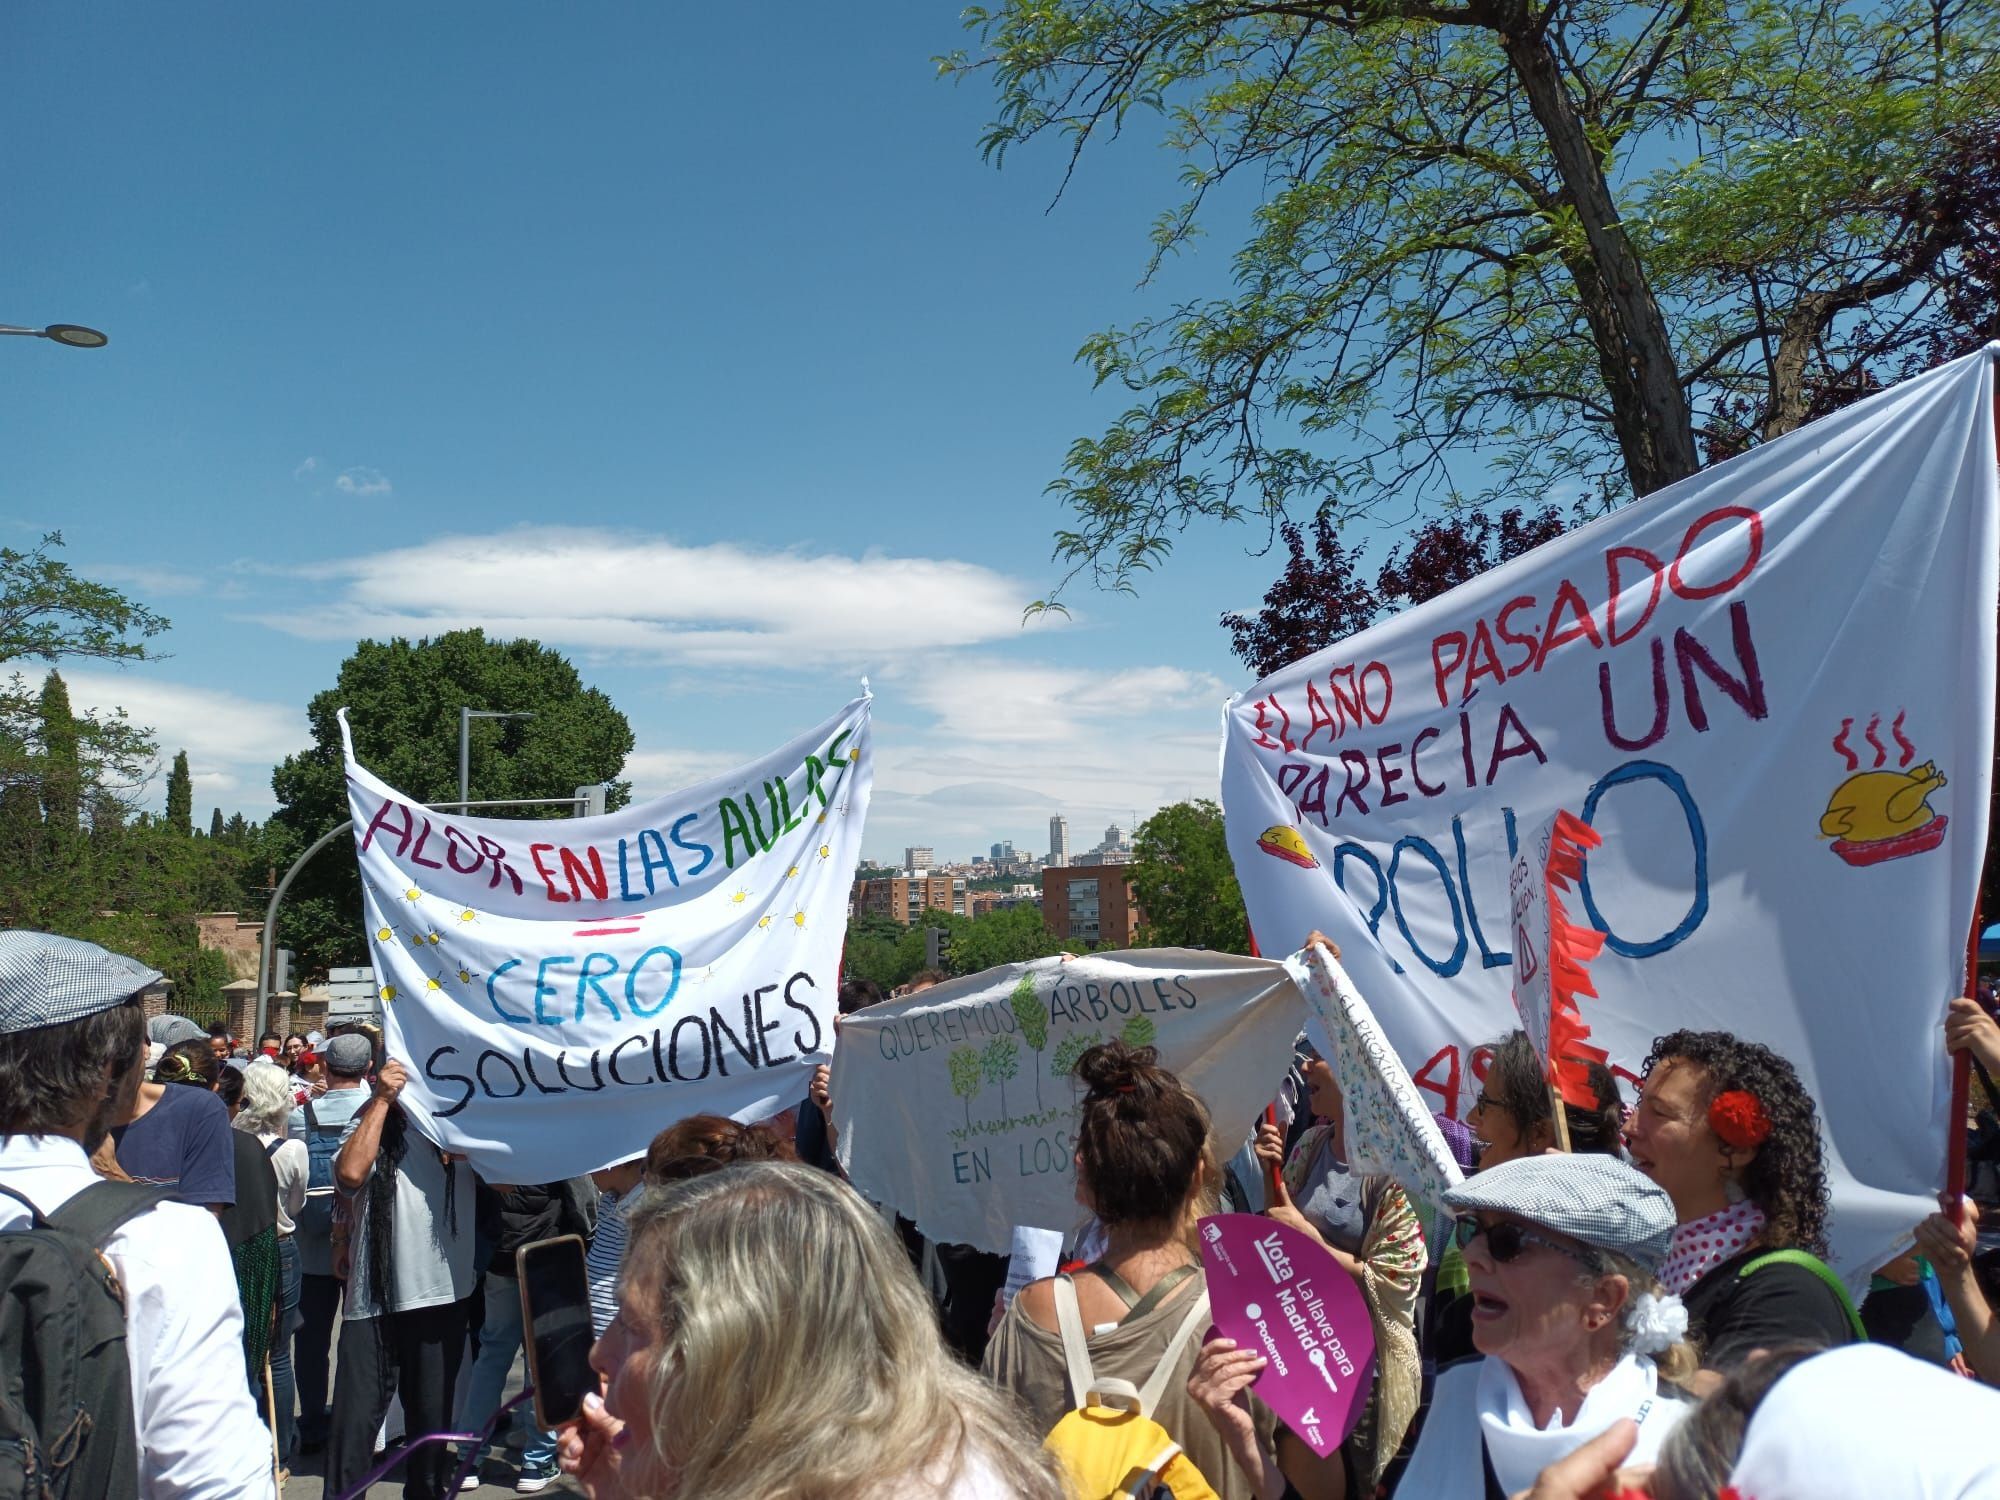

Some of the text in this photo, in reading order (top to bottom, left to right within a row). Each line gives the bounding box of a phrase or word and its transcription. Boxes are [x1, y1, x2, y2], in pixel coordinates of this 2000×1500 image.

[1252, 504, 1764, 753] EL AÑO PASADO
[1278, 600, 1768, 828] PARECÍA UN
[355, 729, 852, 902] ALOR EN LAS AULAS
[486, 945, 683, 1026] CERO
[879, 973, 1198, 1062] QUEREMOS ÁRBOLES
[1339, 994, 1357, 1020] EL
[425, 971, 822, 1117] SOLUCIONES
[952, 1130, 1069, 1185] EN LOS
[1263, 1231, 1295, 1282] Vota
[1255, 1319, 1289, 1378] Podemos
[1276, 1288, 1319, 1353] Madrid
[1296, 1278, 1355, 1378] La llave para
